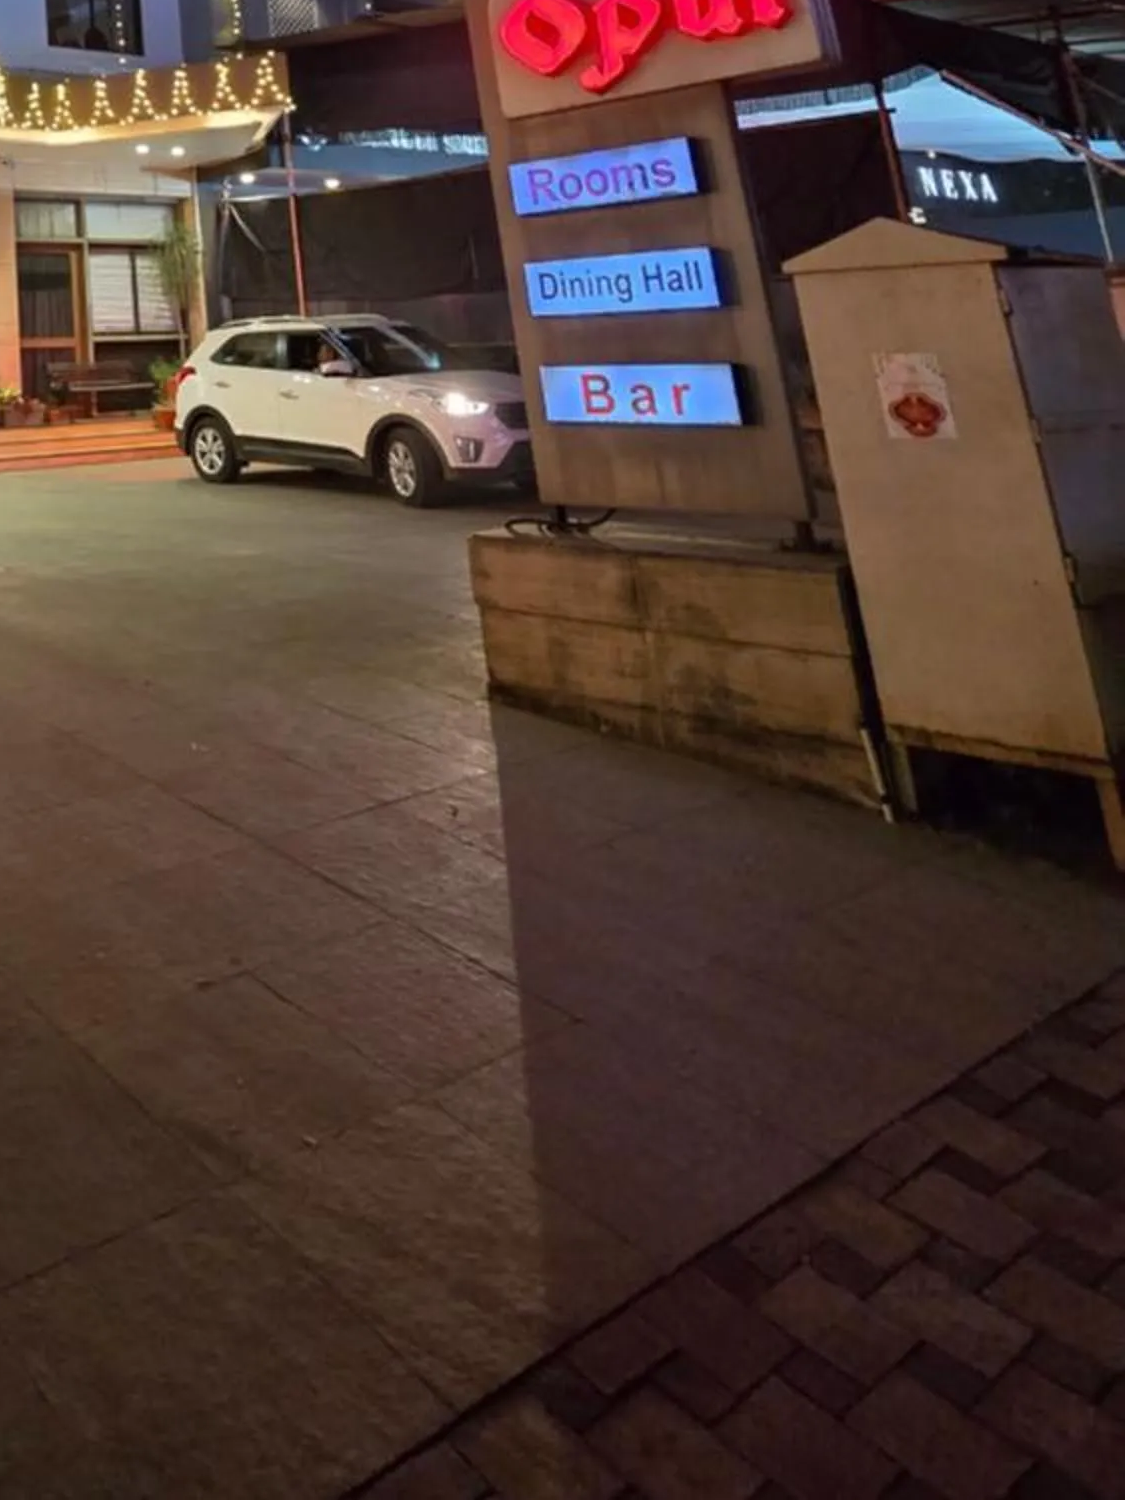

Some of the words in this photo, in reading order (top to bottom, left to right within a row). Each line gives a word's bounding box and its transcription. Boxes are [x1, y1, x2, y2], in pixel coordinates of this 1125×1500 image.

[527, 157, 677, 205] Rooms
[916, 166, 999, 203] NEXA
[538, 269, 634, 303] Dining
[641, 260, 705, 296] Hall
[579, 372, 691, 416] Bar
